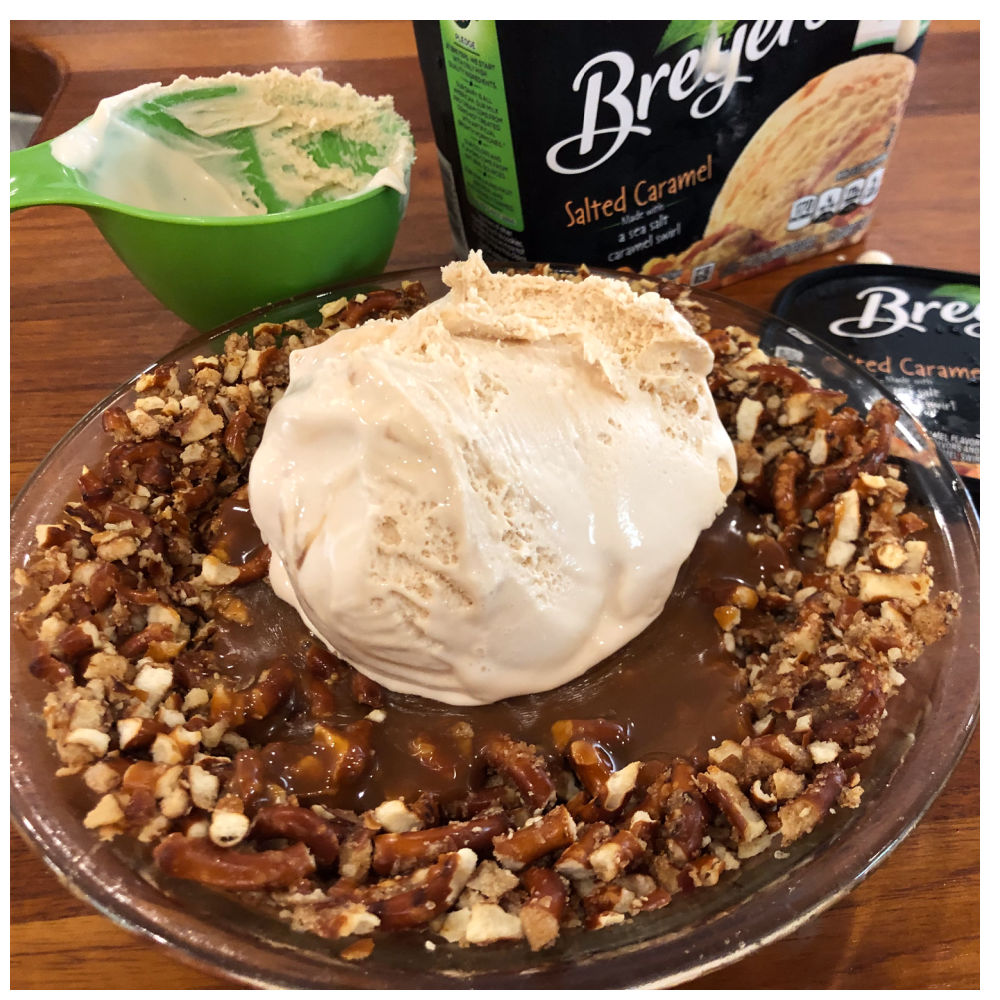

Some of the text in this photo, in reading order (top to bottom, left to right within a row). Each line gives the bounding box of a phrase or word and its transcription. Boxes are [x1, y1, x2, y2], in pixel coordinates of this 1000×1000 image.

[564, 186, 627, 228] Salted
[634, 154, 713, 207] Caramel
[617, 214, 670, 243] a sea salt
[621, 203, 665, 225] Made with
[607, 222, 682, 262] caramel swirl
